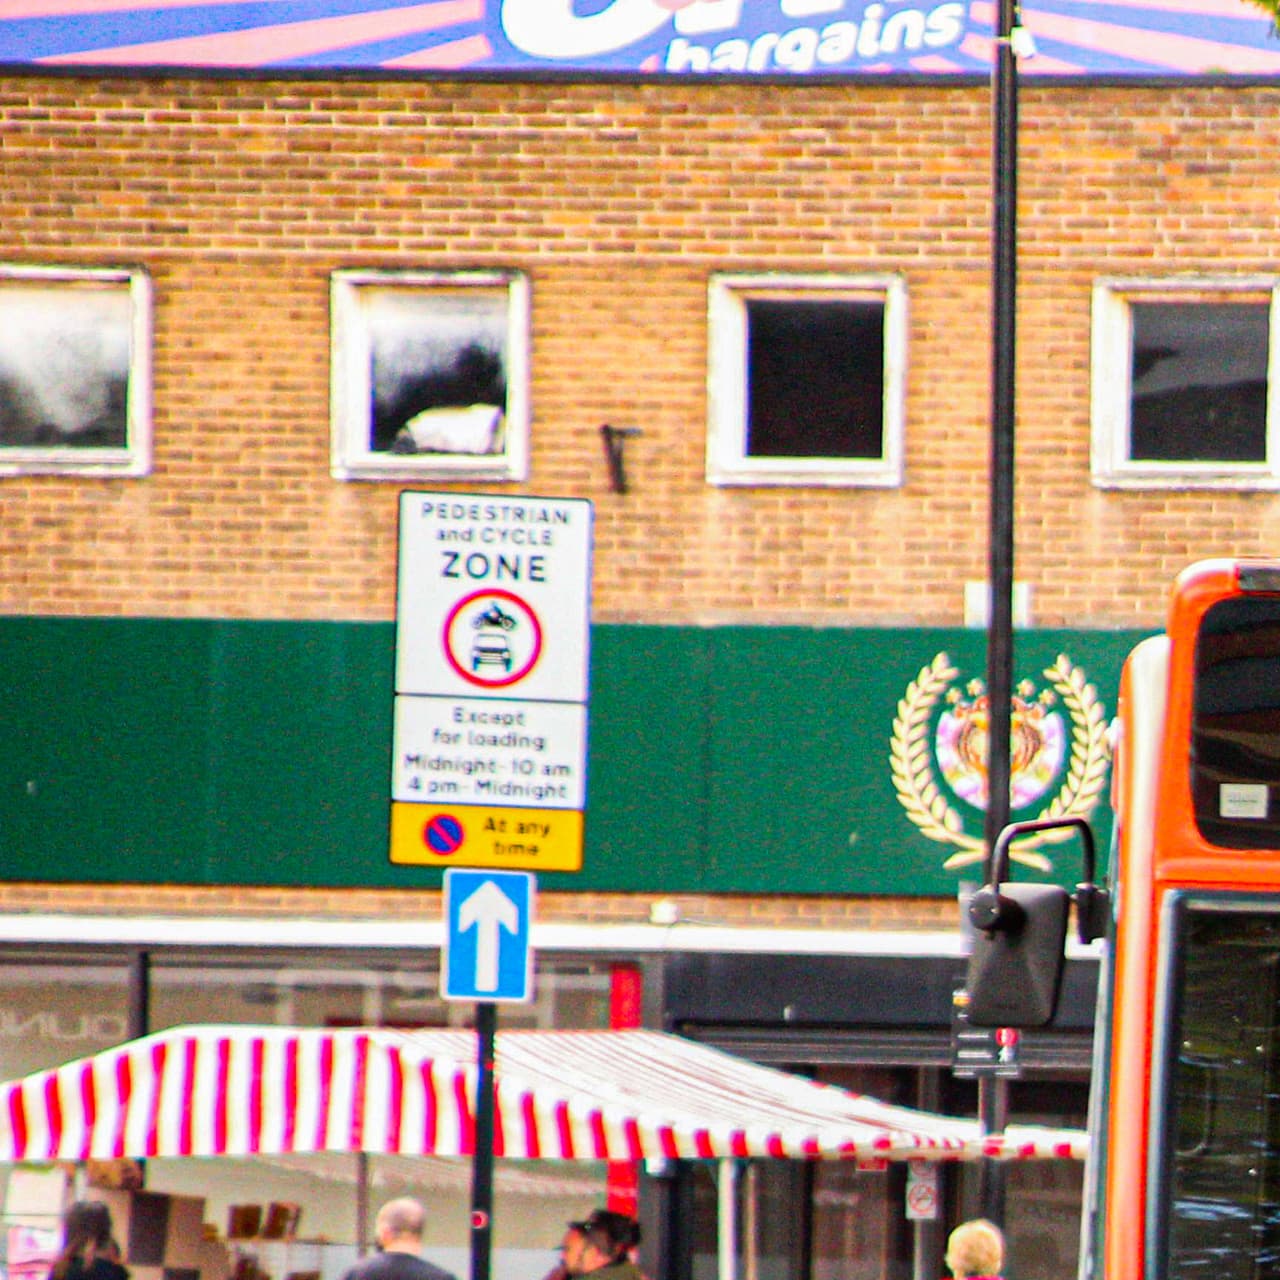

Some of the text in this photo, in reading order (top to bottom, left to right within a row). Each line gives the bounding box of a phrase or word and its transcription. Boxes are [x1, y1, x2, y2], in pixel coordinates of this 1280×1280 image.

[664, 2, 964, 73] bargains
[421, 501, 568, 525] PEDESTRIAN
[436, 527, 553, 546] and CYCLE
[441, 551, 546, 583] ZONE
[453, 706, 526, 726] Except
[432, 727, 545, 752] for loading
[404, 753, 496, 775] Midnight
[512, 759, 535, 775] 10
[542, 763, 571, 776] am
[408, 776, 420, 791] 4
[427, 779, 460, 795] pm
[474, 779, 568, 801] Midnight
[483, 816, 551, 838] At any
[493, 840, 540, 857] time
